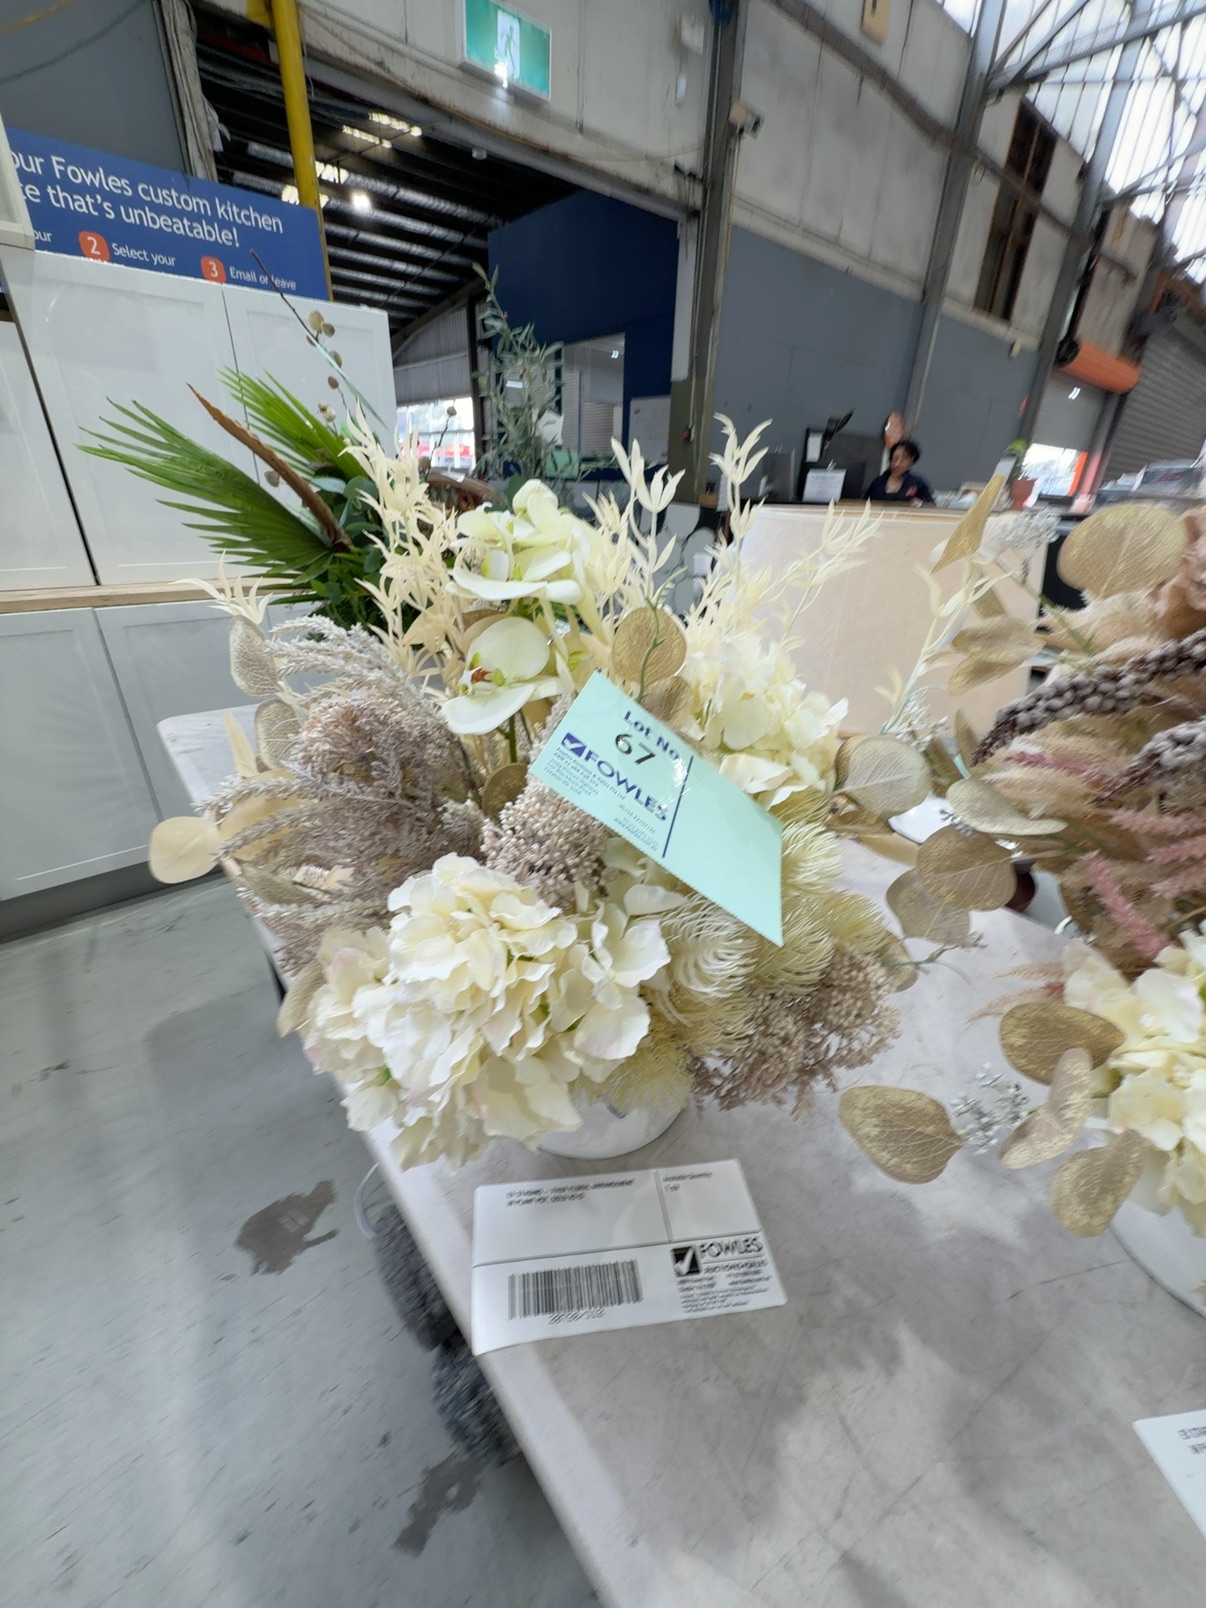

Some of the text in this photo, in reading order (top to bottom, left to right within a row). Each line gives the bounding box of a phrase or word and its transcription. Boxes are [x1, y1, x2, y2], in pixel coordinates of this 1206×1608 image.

[51, 154, 133, 197] Fowles
[138, 182, 213, 217] custom
[215, 195, 284, 235] kitchen
[47, 184, 116, 220] that's
[120, 204, 240, 248] unbeatable!
[87, 236, 102, 256] 2
[111, 242, 177, 267] Select your
[208, 260, 219, 278] 3
[229, 265, 258, 284] Email
[623, 710, 653, 740] Lot
[614, 733, 657, 766] 67
[584, 749, 668, 822] FOWLES
[700, 1237, 764, 1259] FOWLES
